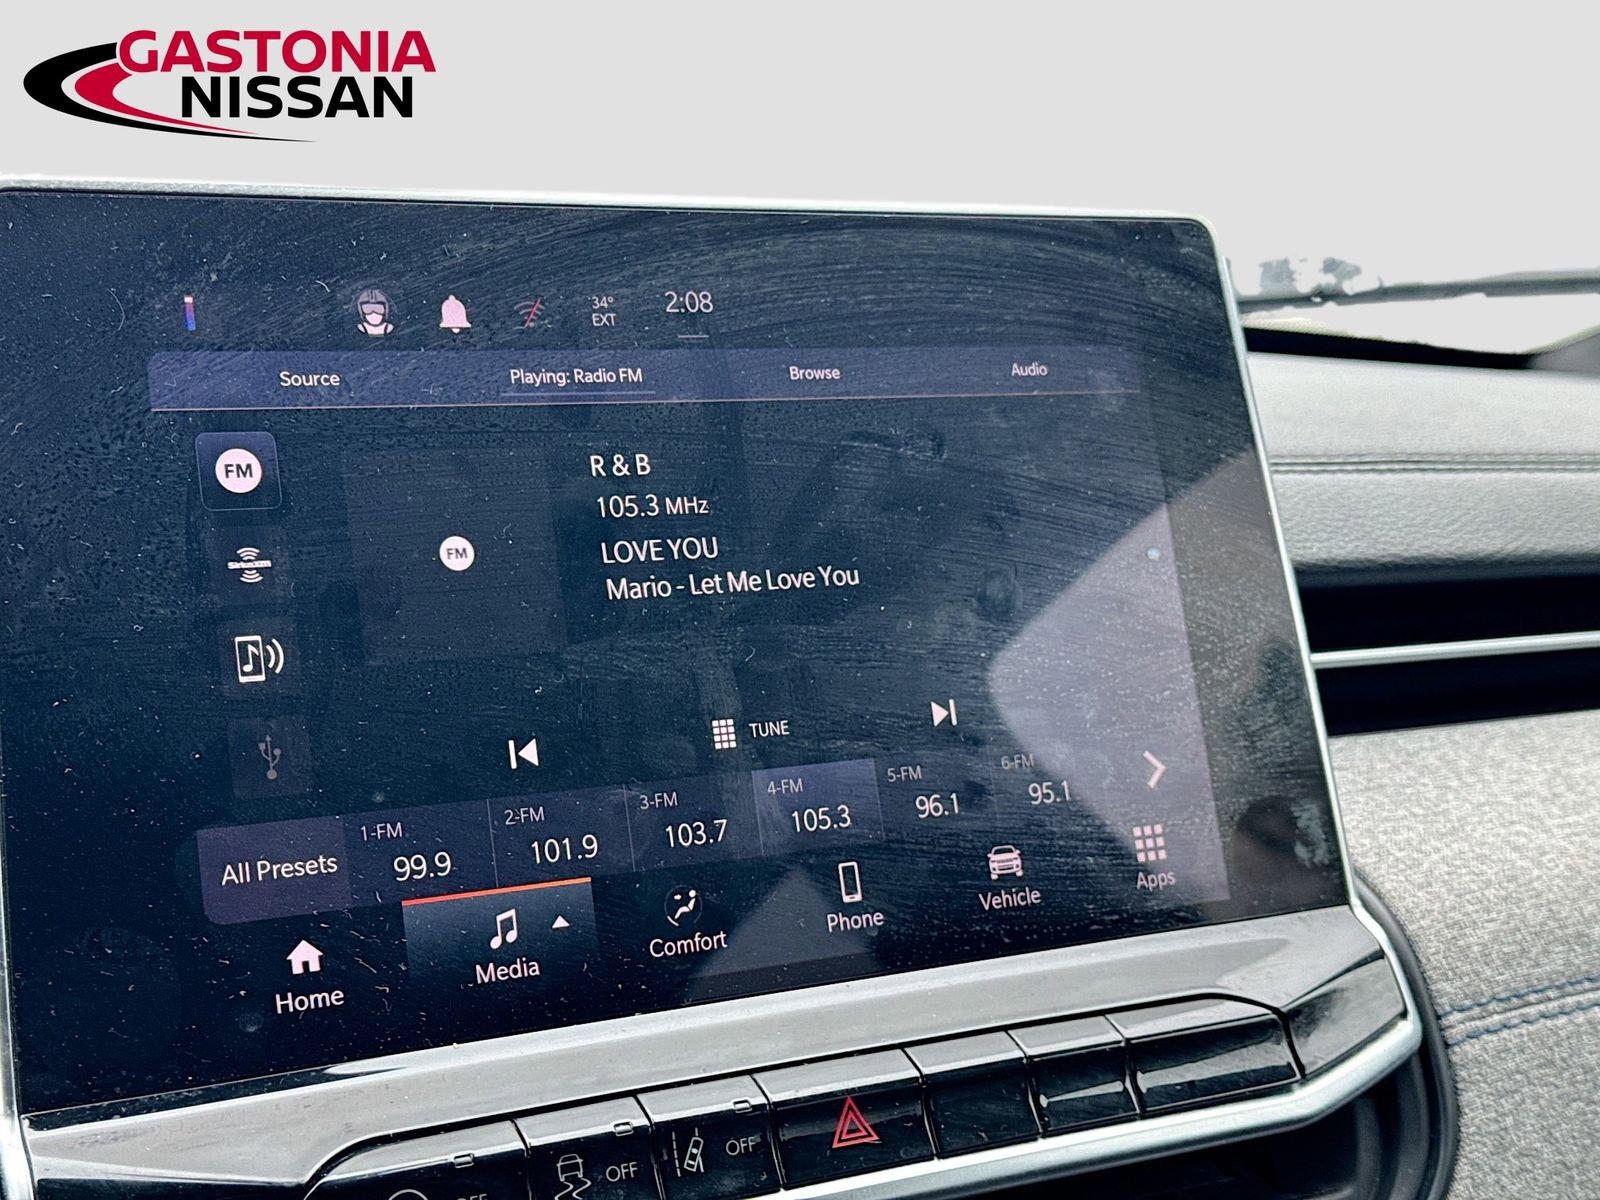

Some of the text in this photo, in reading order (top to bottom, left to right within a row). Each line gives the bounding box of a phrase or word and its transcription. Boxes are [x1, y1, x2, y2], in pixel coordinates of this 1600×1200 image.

[665, 291, 713, 312] 2:08
[592, 313, 616, 326] EXT
[280, 372, 339, 386] Source
[511, 368, 642, 386] Playing: Radio FM
[790, 366, 840, 379] Browse
[1012, 363, 1047, 376] Audio
[224, 464, 252, 478] FM
[590, 454, 650, 476] R & B
[597, 494, 708, 517] 105.3 MHz
[447, 548, 467, 559] FM
[602, 537, 717, 563] LOVE YOU
[607, 575, 671, 599] Mario
[689, 574, 723, 594] Let
[727, 571, 761, 592] Me
[766, 570, 815, 589] Love
[818, 566, 859, 586] You
[749, 720, 789, 737] TUNE
[1001, 754, 1034, 769] 6-FM
[888, 766, 922, 782] 5-FM
[768, 778, 802, 794] 4-FM
[1029, 780, 1070, 804] 95.1
[640, 792, 677, 809] 3-FM
[916, 793, 958, 818] 96.1
[505, 807, 544, 824] 2-FM
[792, 805, 851, 832] 105.3
[361, 822, 402, 840] 1-FM
[666, 819, 727, 847] 103.7
[532, 835, 597, 863] 101.9
[222, 856, 337, 885] All Presets
[394, 852, 451, 881] 99.9
[1137, 869, 1176, 890] Apps
[979, 887, 1041, 910] Vehicle
[827, 913, 883, 932] Phone
[650, 931, 727, 957] Comfort
[476, 958, 539, 983] Media
[276, 991, 344, 1013] Home
[726, 1138, 757, 1156] OFF
[606, 1162, 637, 1181] OFF
